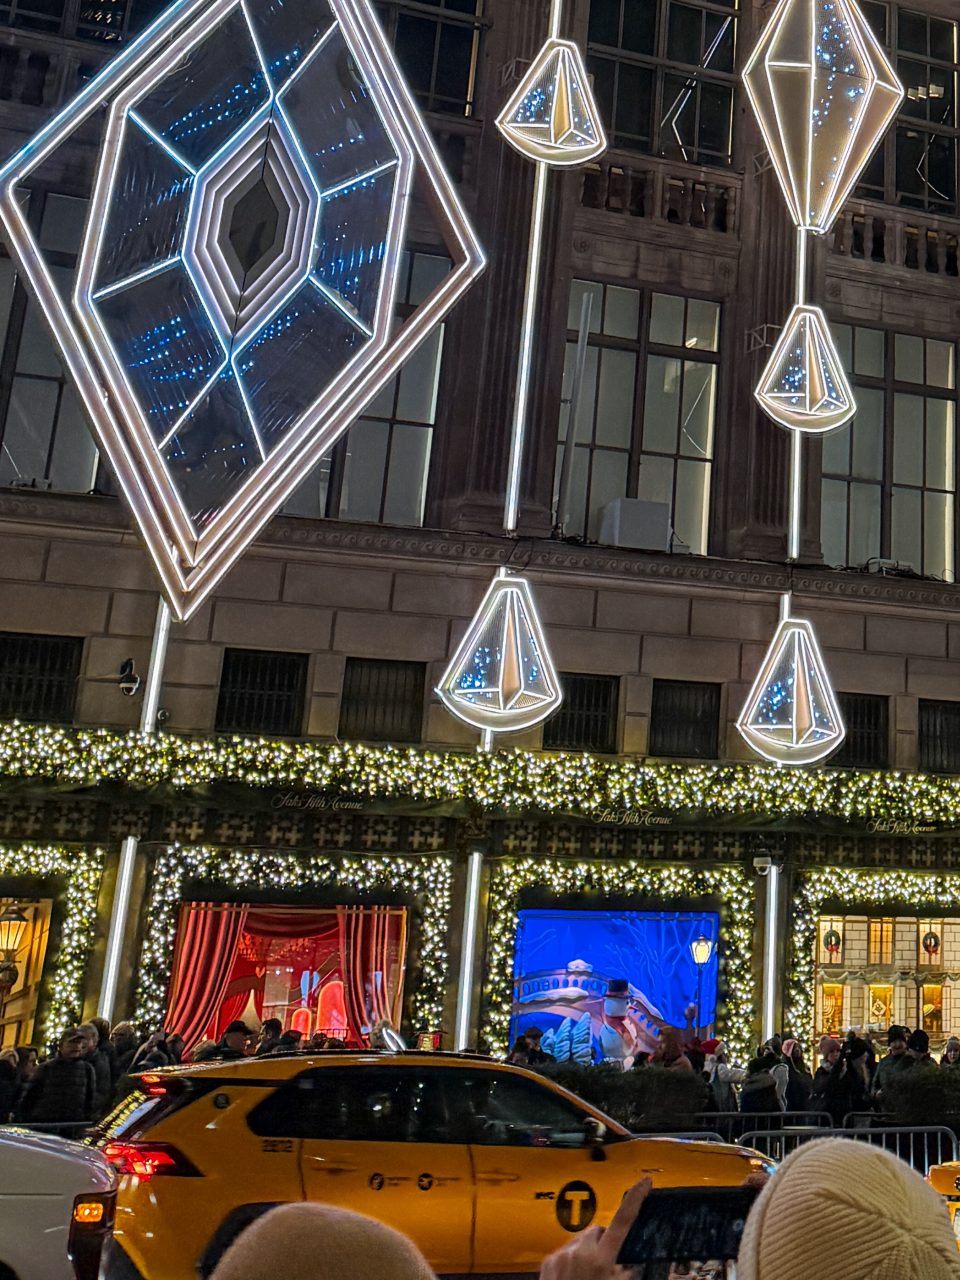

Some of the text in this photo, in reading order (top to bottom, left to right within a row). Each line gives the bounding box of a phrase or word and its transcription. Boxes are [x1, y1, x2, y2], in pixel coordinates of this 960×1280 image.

[271, 791, 363, 811] Saks Fifth Avenue
[591, 807, 673, 826] Saks Fifth Avenue
[866, 818, 889, 833] Saks
[564, 1190, 590, 1226] T
